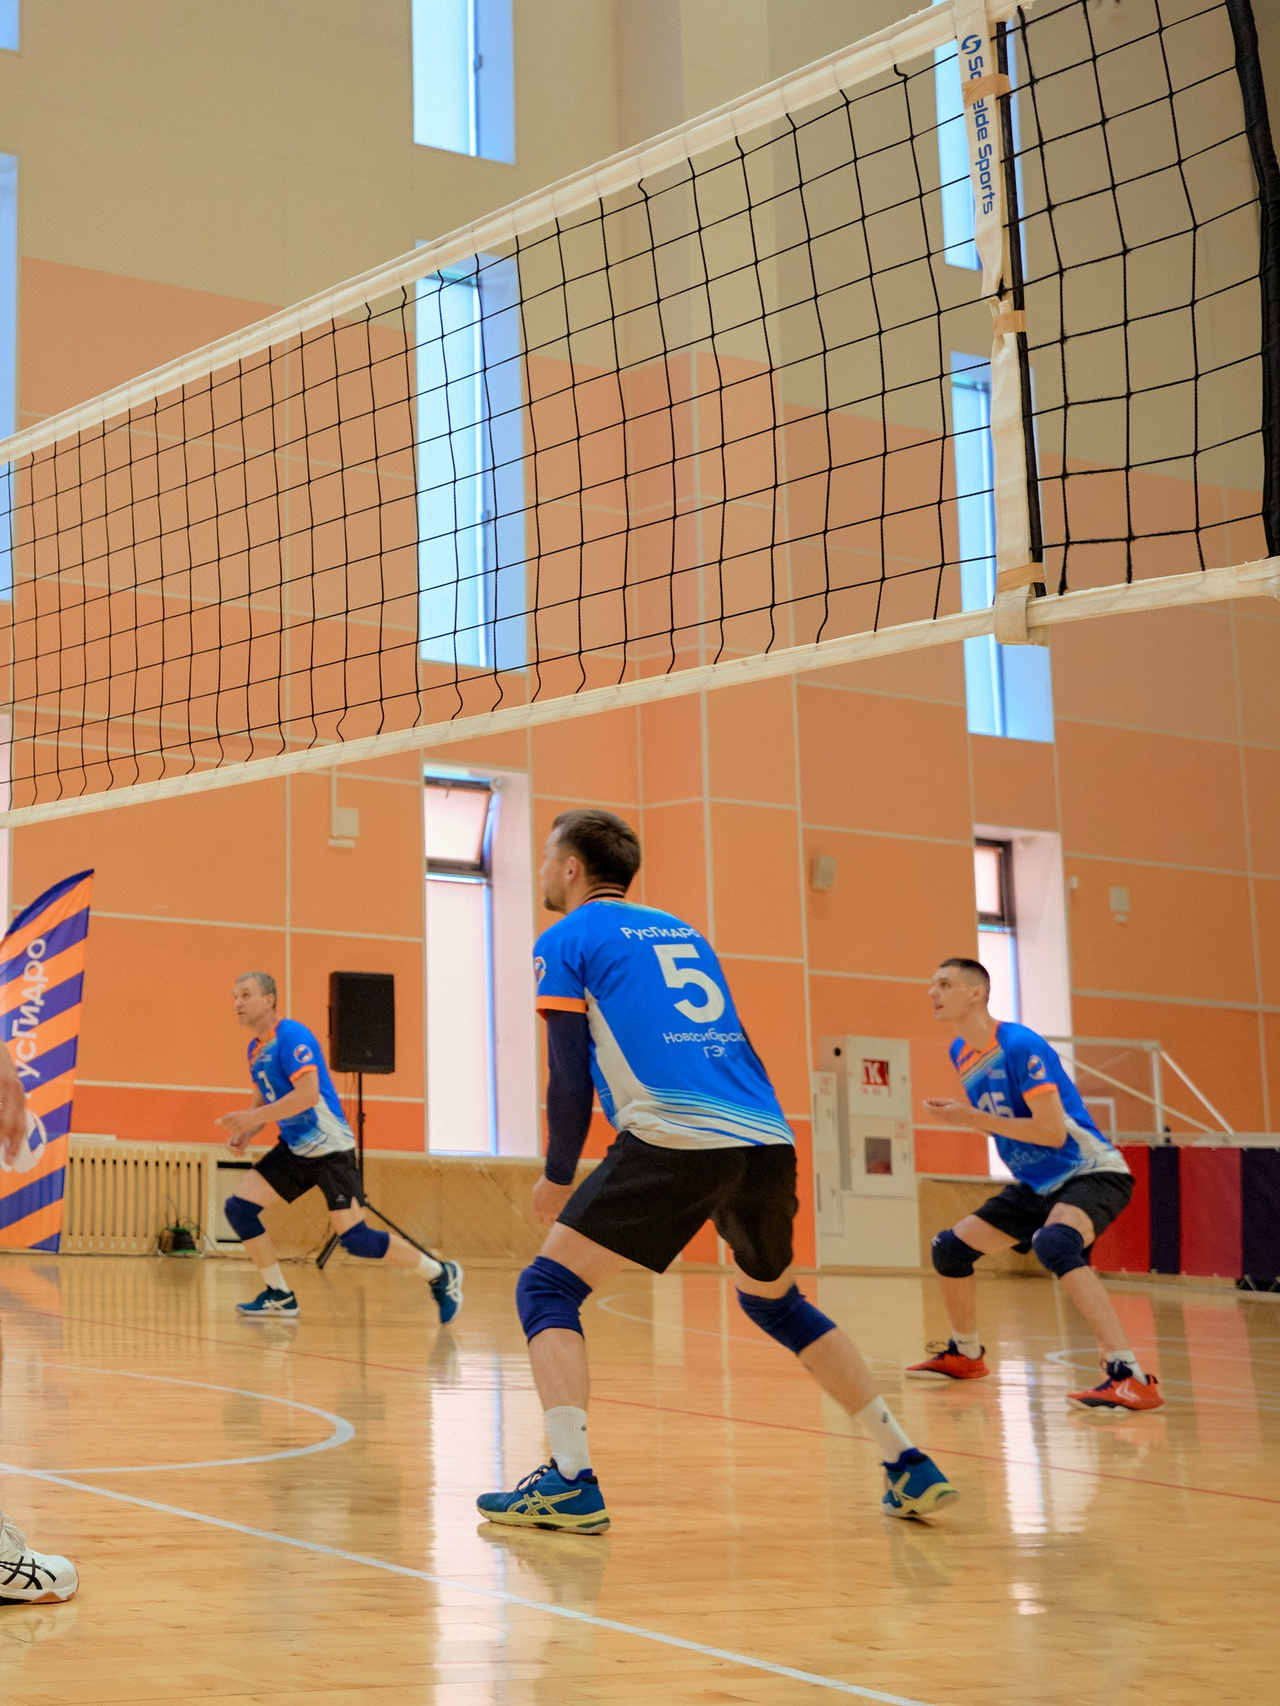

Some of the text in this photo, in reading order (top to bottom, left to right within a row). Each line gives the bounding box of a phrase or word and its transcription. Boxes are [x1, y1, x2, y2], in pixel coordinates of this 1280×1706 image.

[968, 55, 996, 215] Scelde Sports
[12, 938, 49, 1098] усГидро
[652, 943, 725, 1023] 5
